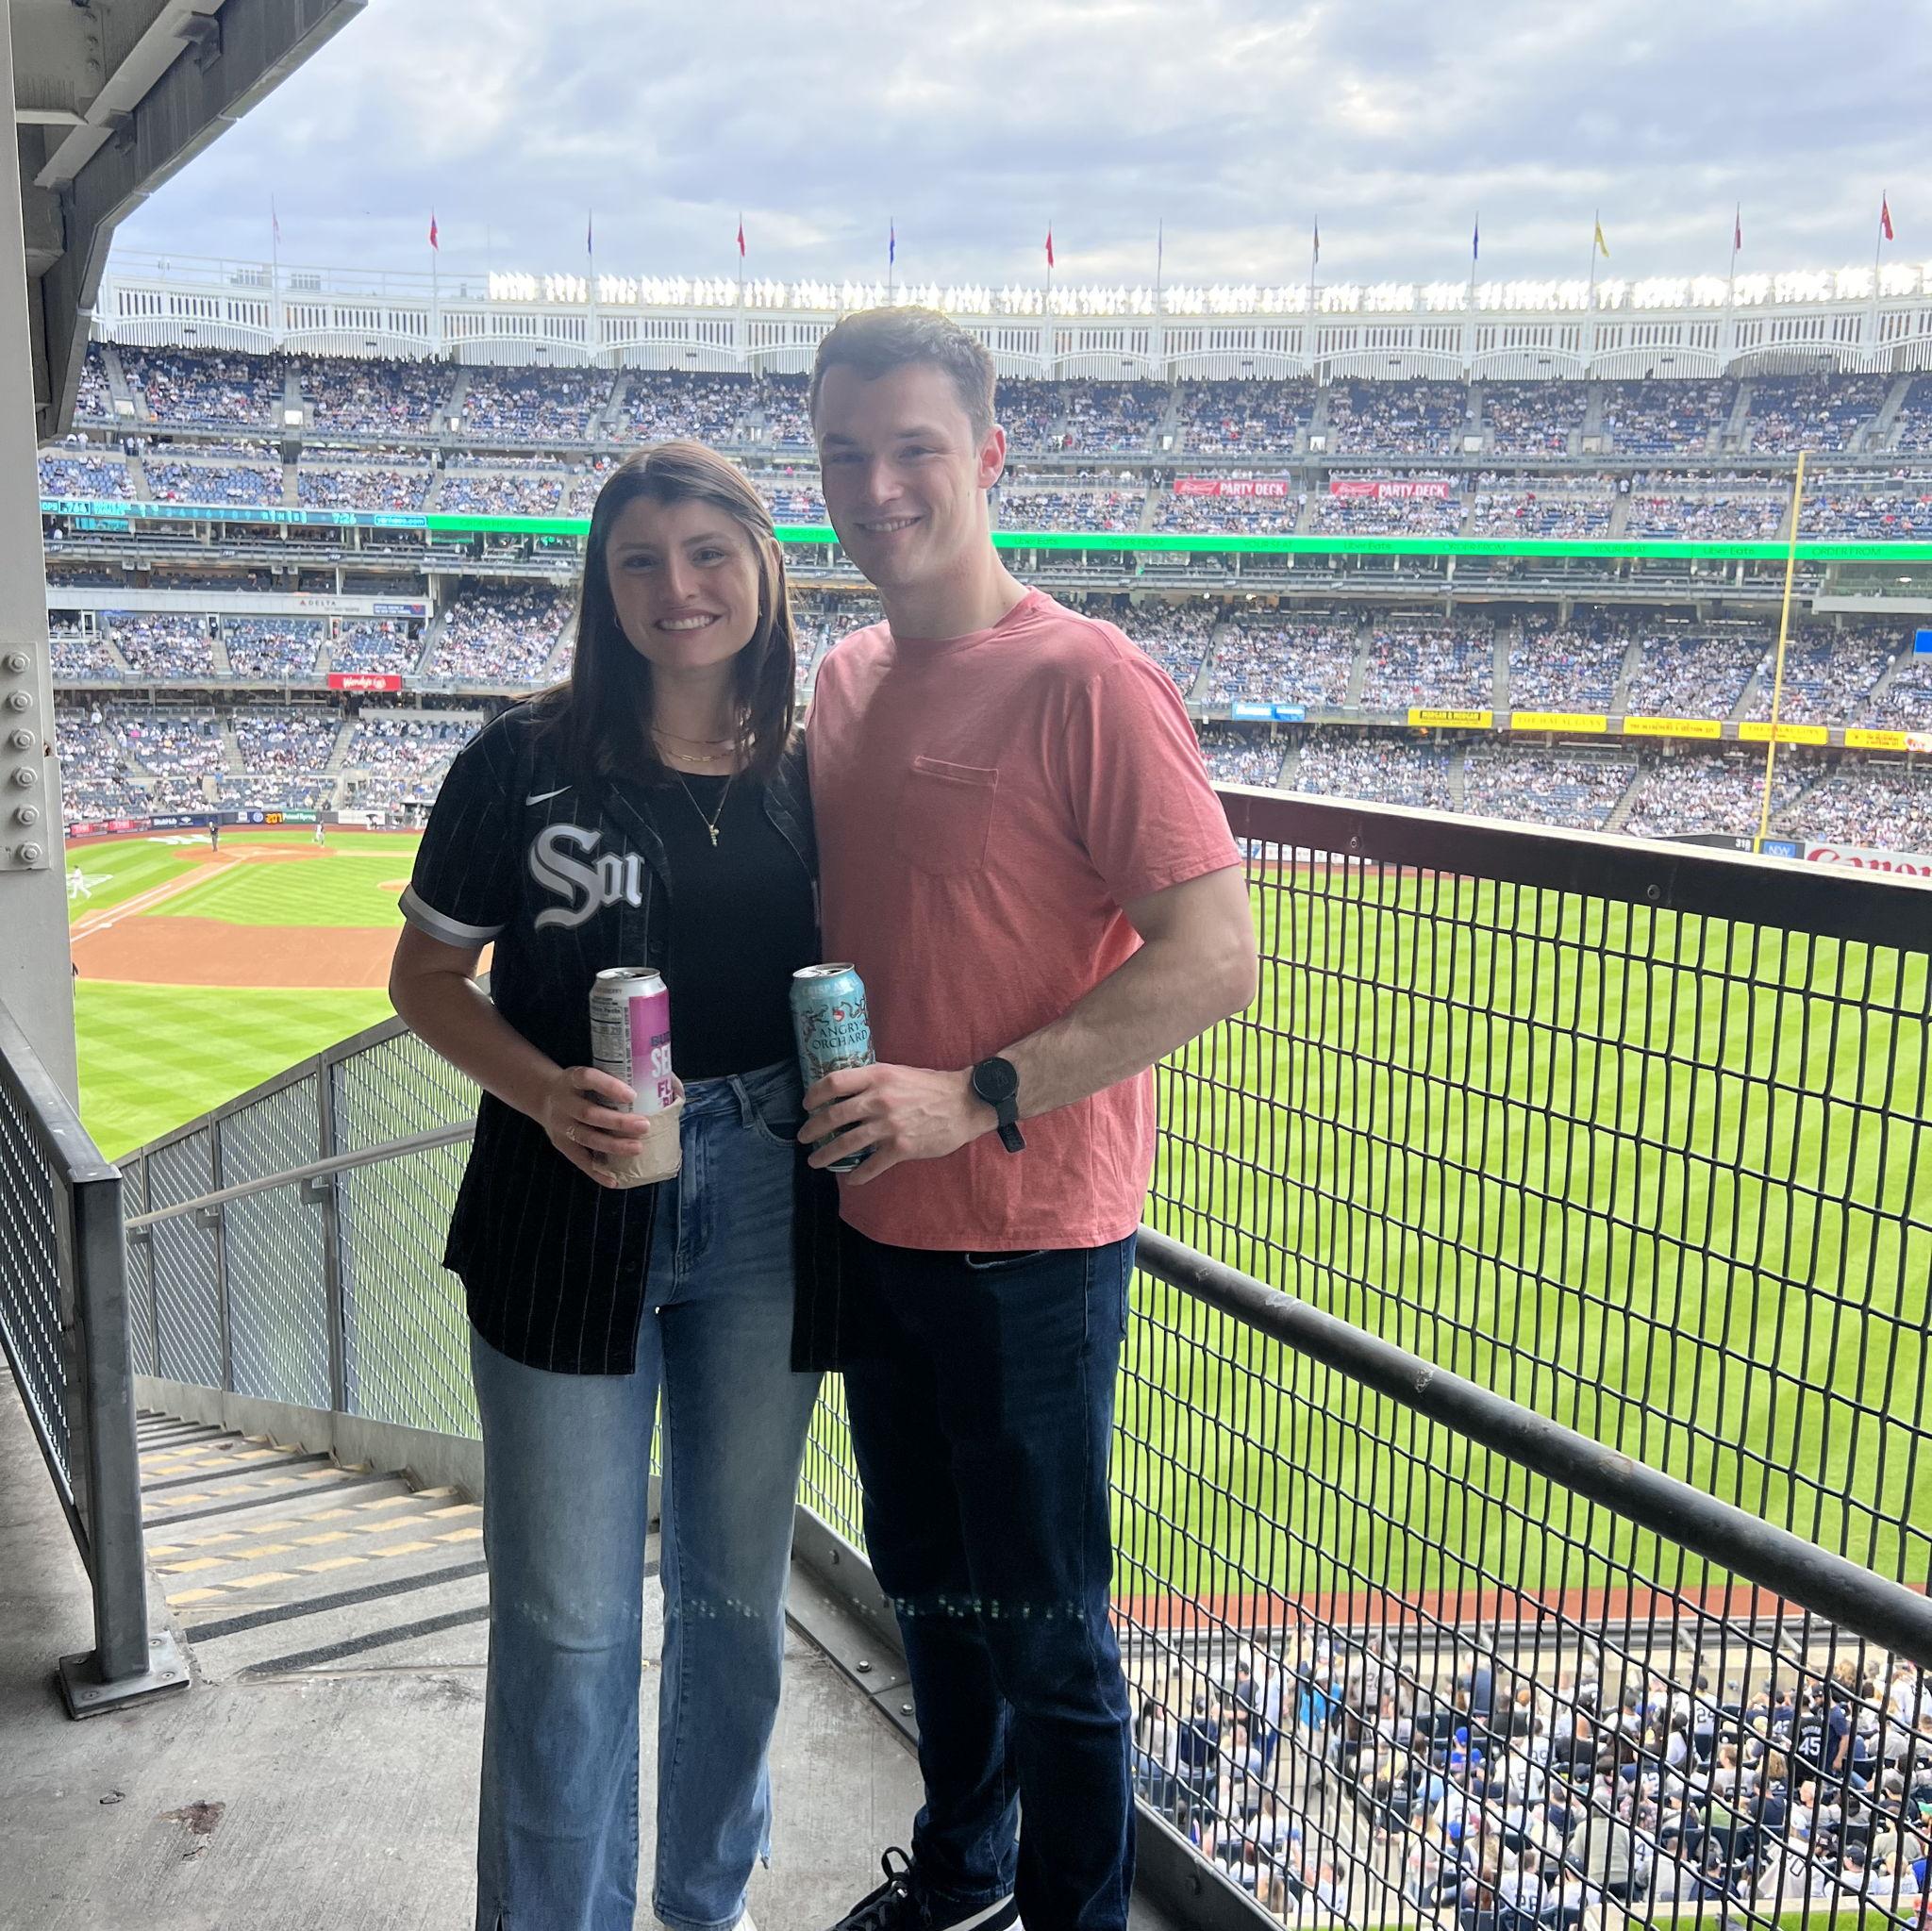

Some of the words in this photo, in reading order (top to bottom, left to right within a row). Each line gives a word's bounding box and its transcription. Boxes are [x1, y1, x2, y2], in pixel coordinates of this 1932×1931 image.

[1220, 481, 1254, 496] PARTY
[1255, 482, 1284, 497] DECK
[1378, 483, 1414, 499] PARTY
[1415, 484, 1445, 498] DECK
[820, 1021, 859, 1039] ANGRY
[811, 1029, 868, 1050] ORCHARD
[1797, 1737, 1822, 1756] 45
